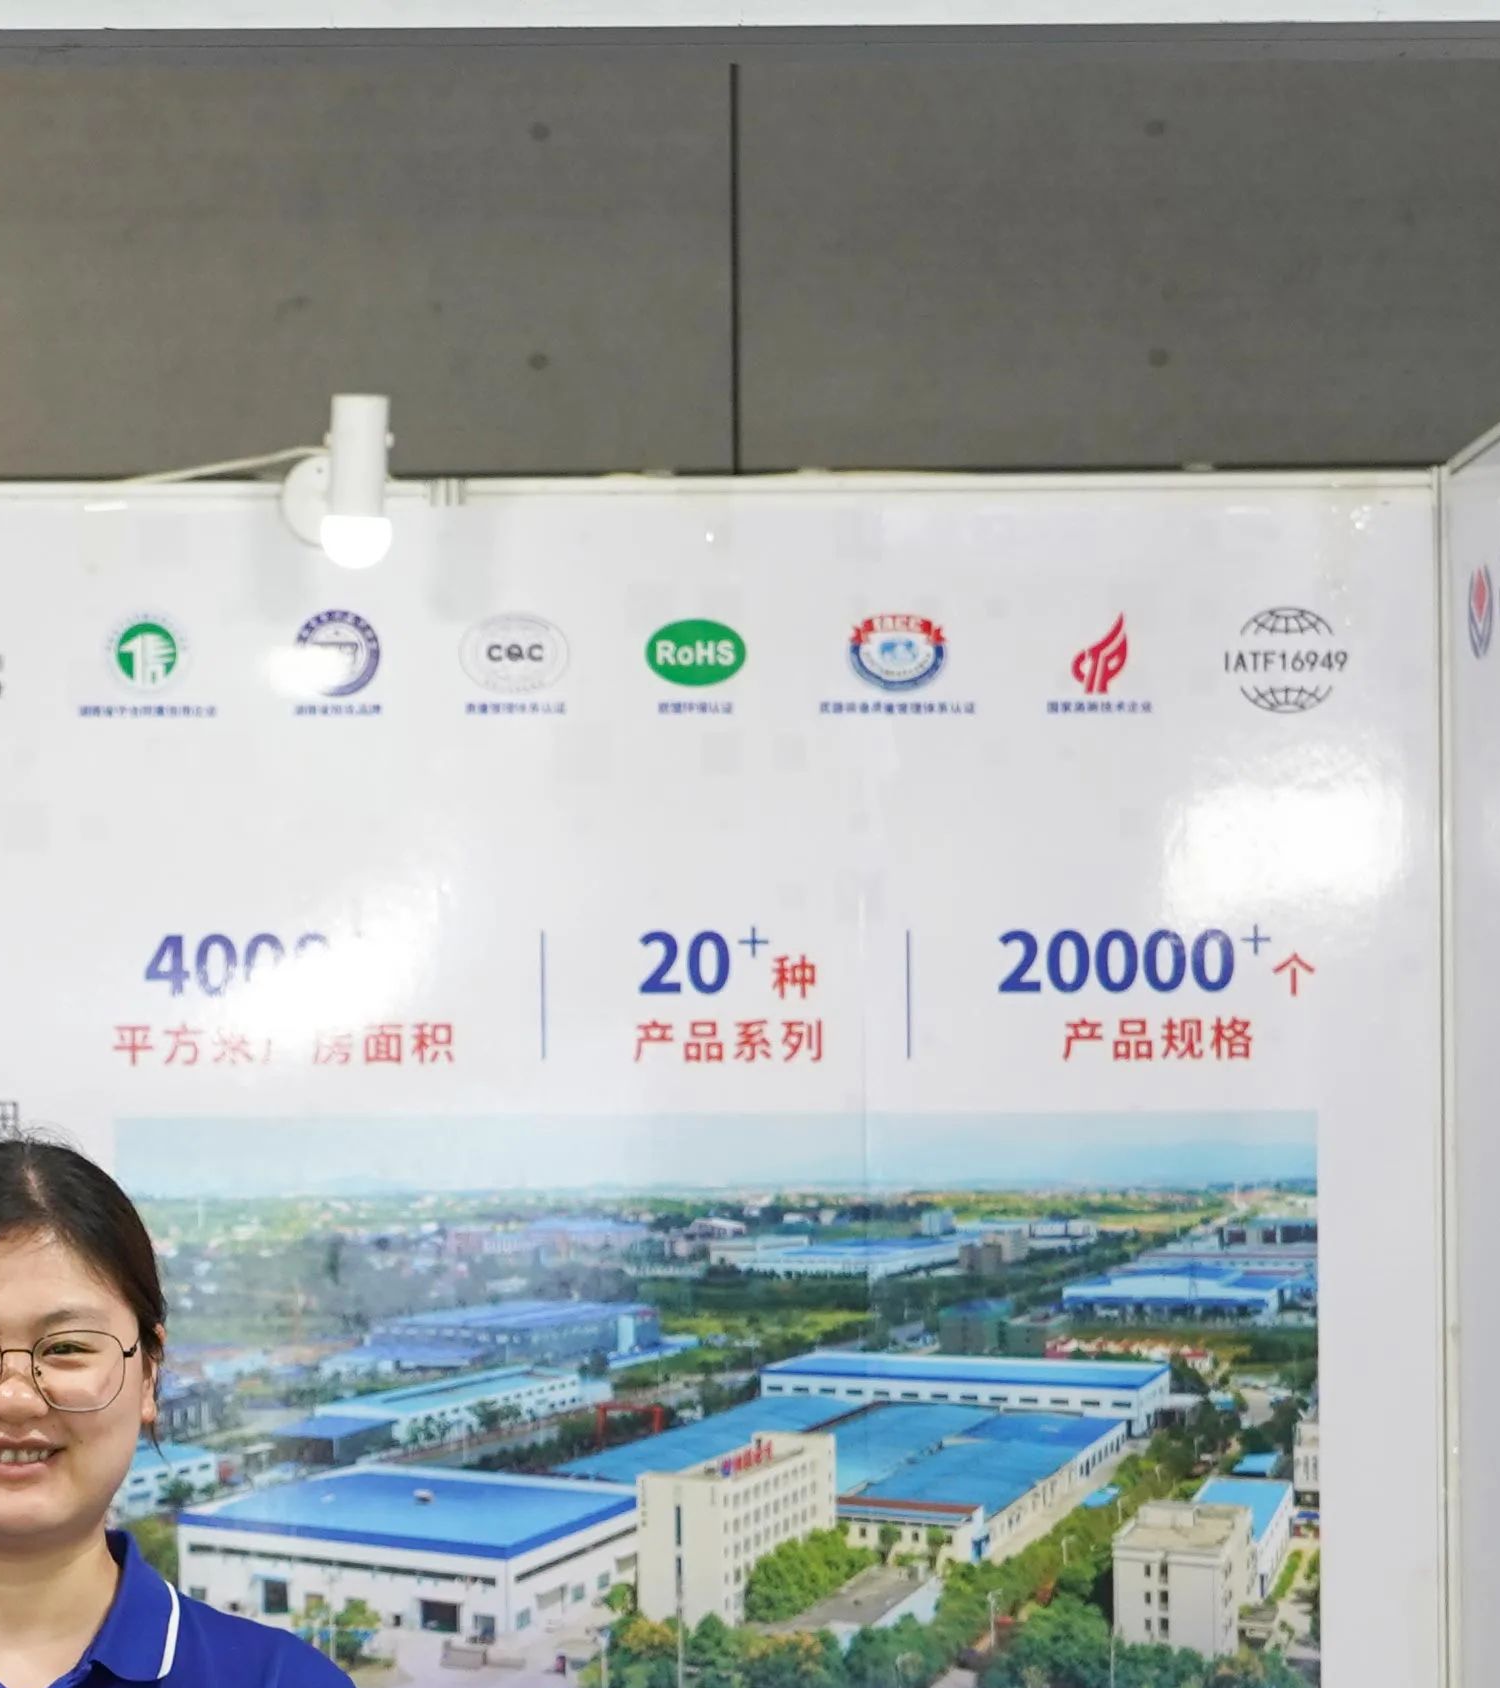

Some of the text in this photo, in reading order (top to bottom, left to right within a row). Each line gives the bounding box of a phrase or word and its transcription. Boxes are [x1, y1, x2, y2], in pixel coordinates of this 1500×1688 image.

[487, 644, 544, 661] CQC
[655, 638, 735, 666] RoHS
[1223, 650, 1347, 674] IATF16949
[633, 1018, 824, 1063] 产品系列
[1061, 1016, 1254, 1061] 产品规格
